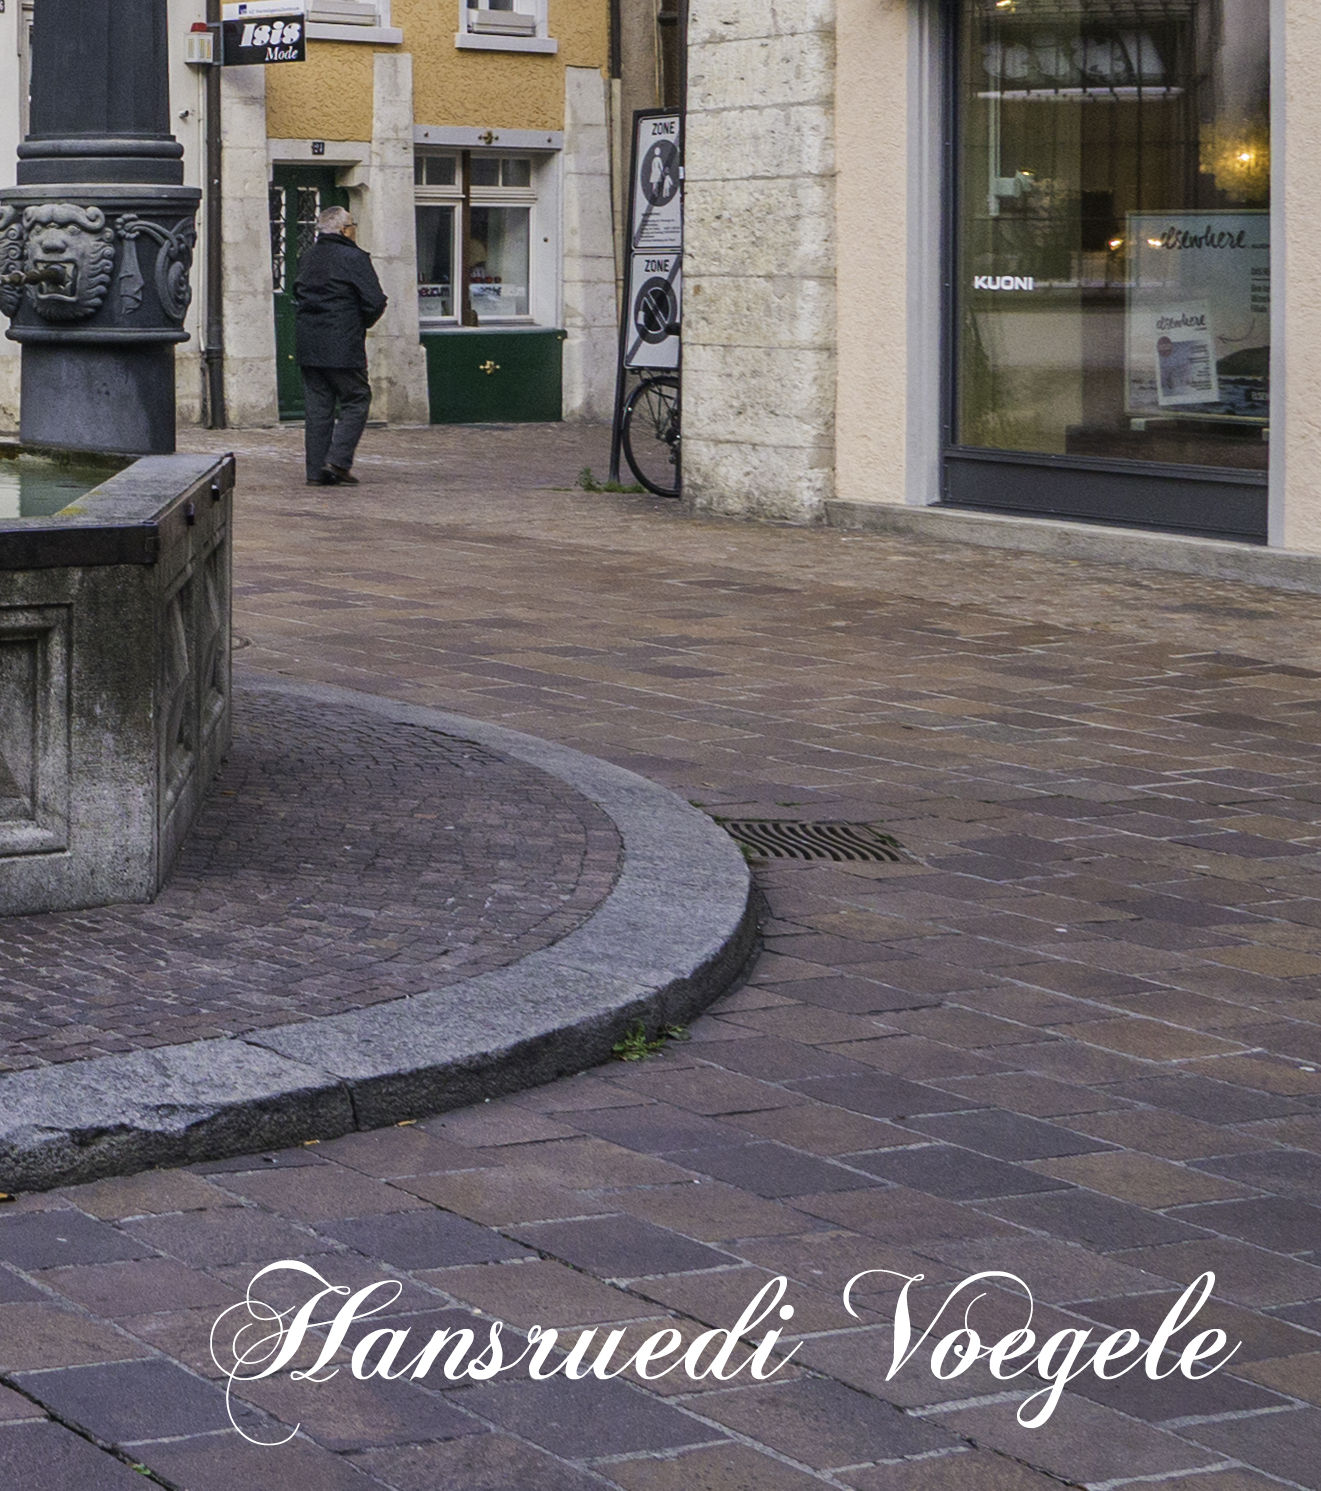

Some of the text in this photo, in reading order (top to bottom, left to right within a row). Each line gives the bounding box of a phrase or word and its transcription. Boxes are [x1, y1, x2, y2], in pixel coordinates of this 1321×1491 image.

[239, 21, 301, 47] Isis
[265, 46, 299, 61] Mode
[652, 121, 676, 136] ZONE
[1160, 216, 1247, 250] elsewhere
[645, 260, 670, 272] ZONE
[974, 275, 1034, 291] KUONI
